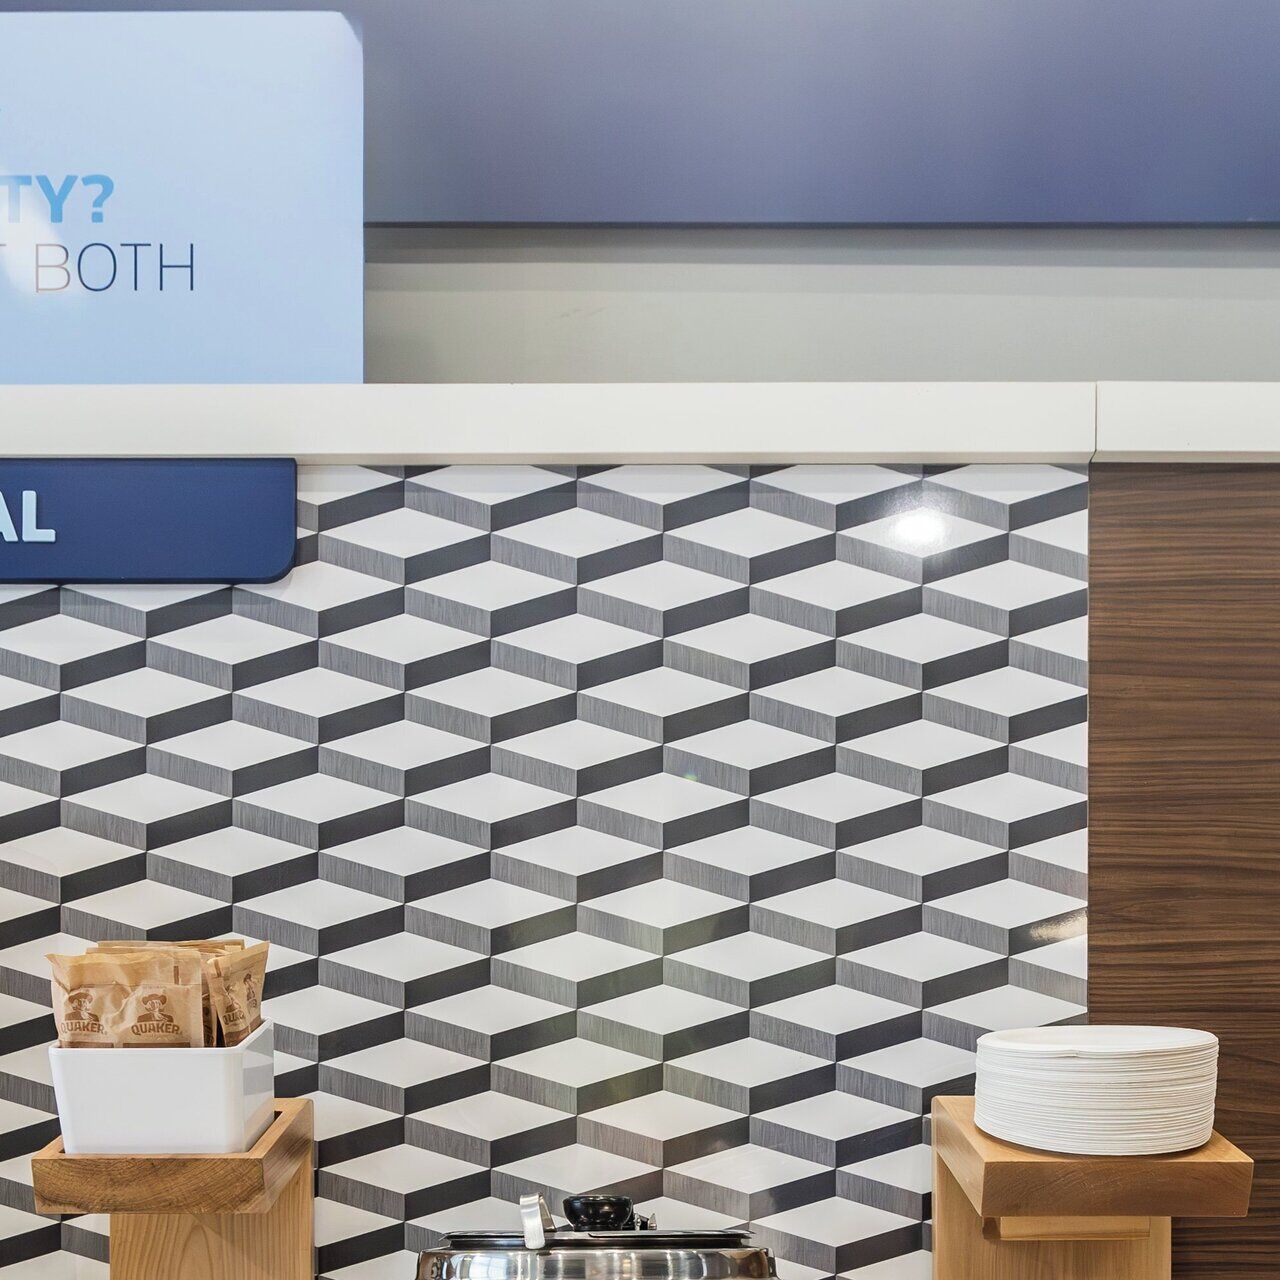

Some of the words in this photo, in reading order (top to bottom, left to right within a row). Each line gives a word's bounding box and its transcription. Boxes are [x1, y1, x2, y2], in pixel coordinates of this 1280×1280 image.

[35, 242, 195, 293] BOTH
[60, 1021, 106, 1036] QUAKER
[131, 1021, 181, 1036] QUAKER
